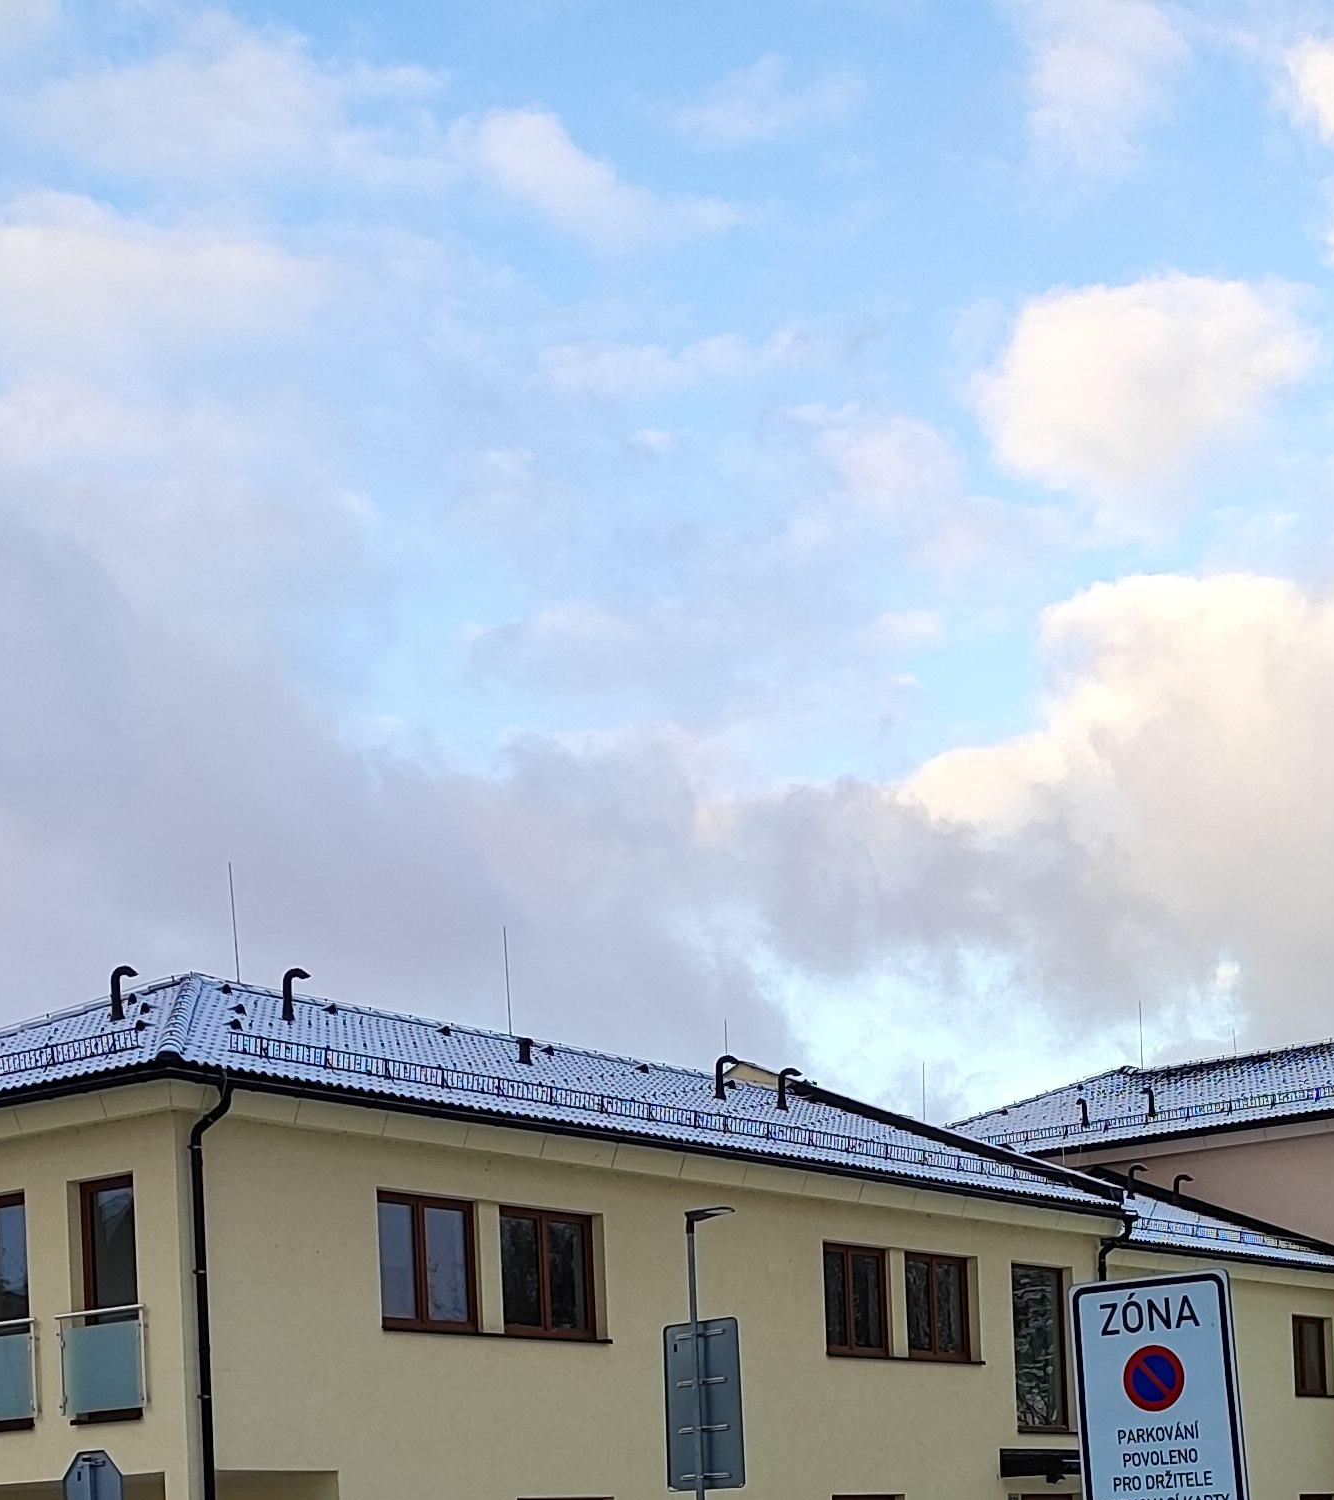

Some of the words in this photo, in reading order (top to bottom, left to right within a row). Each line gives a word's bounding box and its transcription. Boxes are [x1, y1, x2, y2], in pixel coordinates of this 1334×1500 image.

[1099, 1292, 1201, 1336] ZÓNA
[1117, 1420, 1199, 1445] PARKOVÁNÍ
[1122, 1447, 1198, 1468] POVOLENO
[1112, 1476, 1142, 1492] PRO
[1145, 1470, 1213, 1490] DRŽITELE
